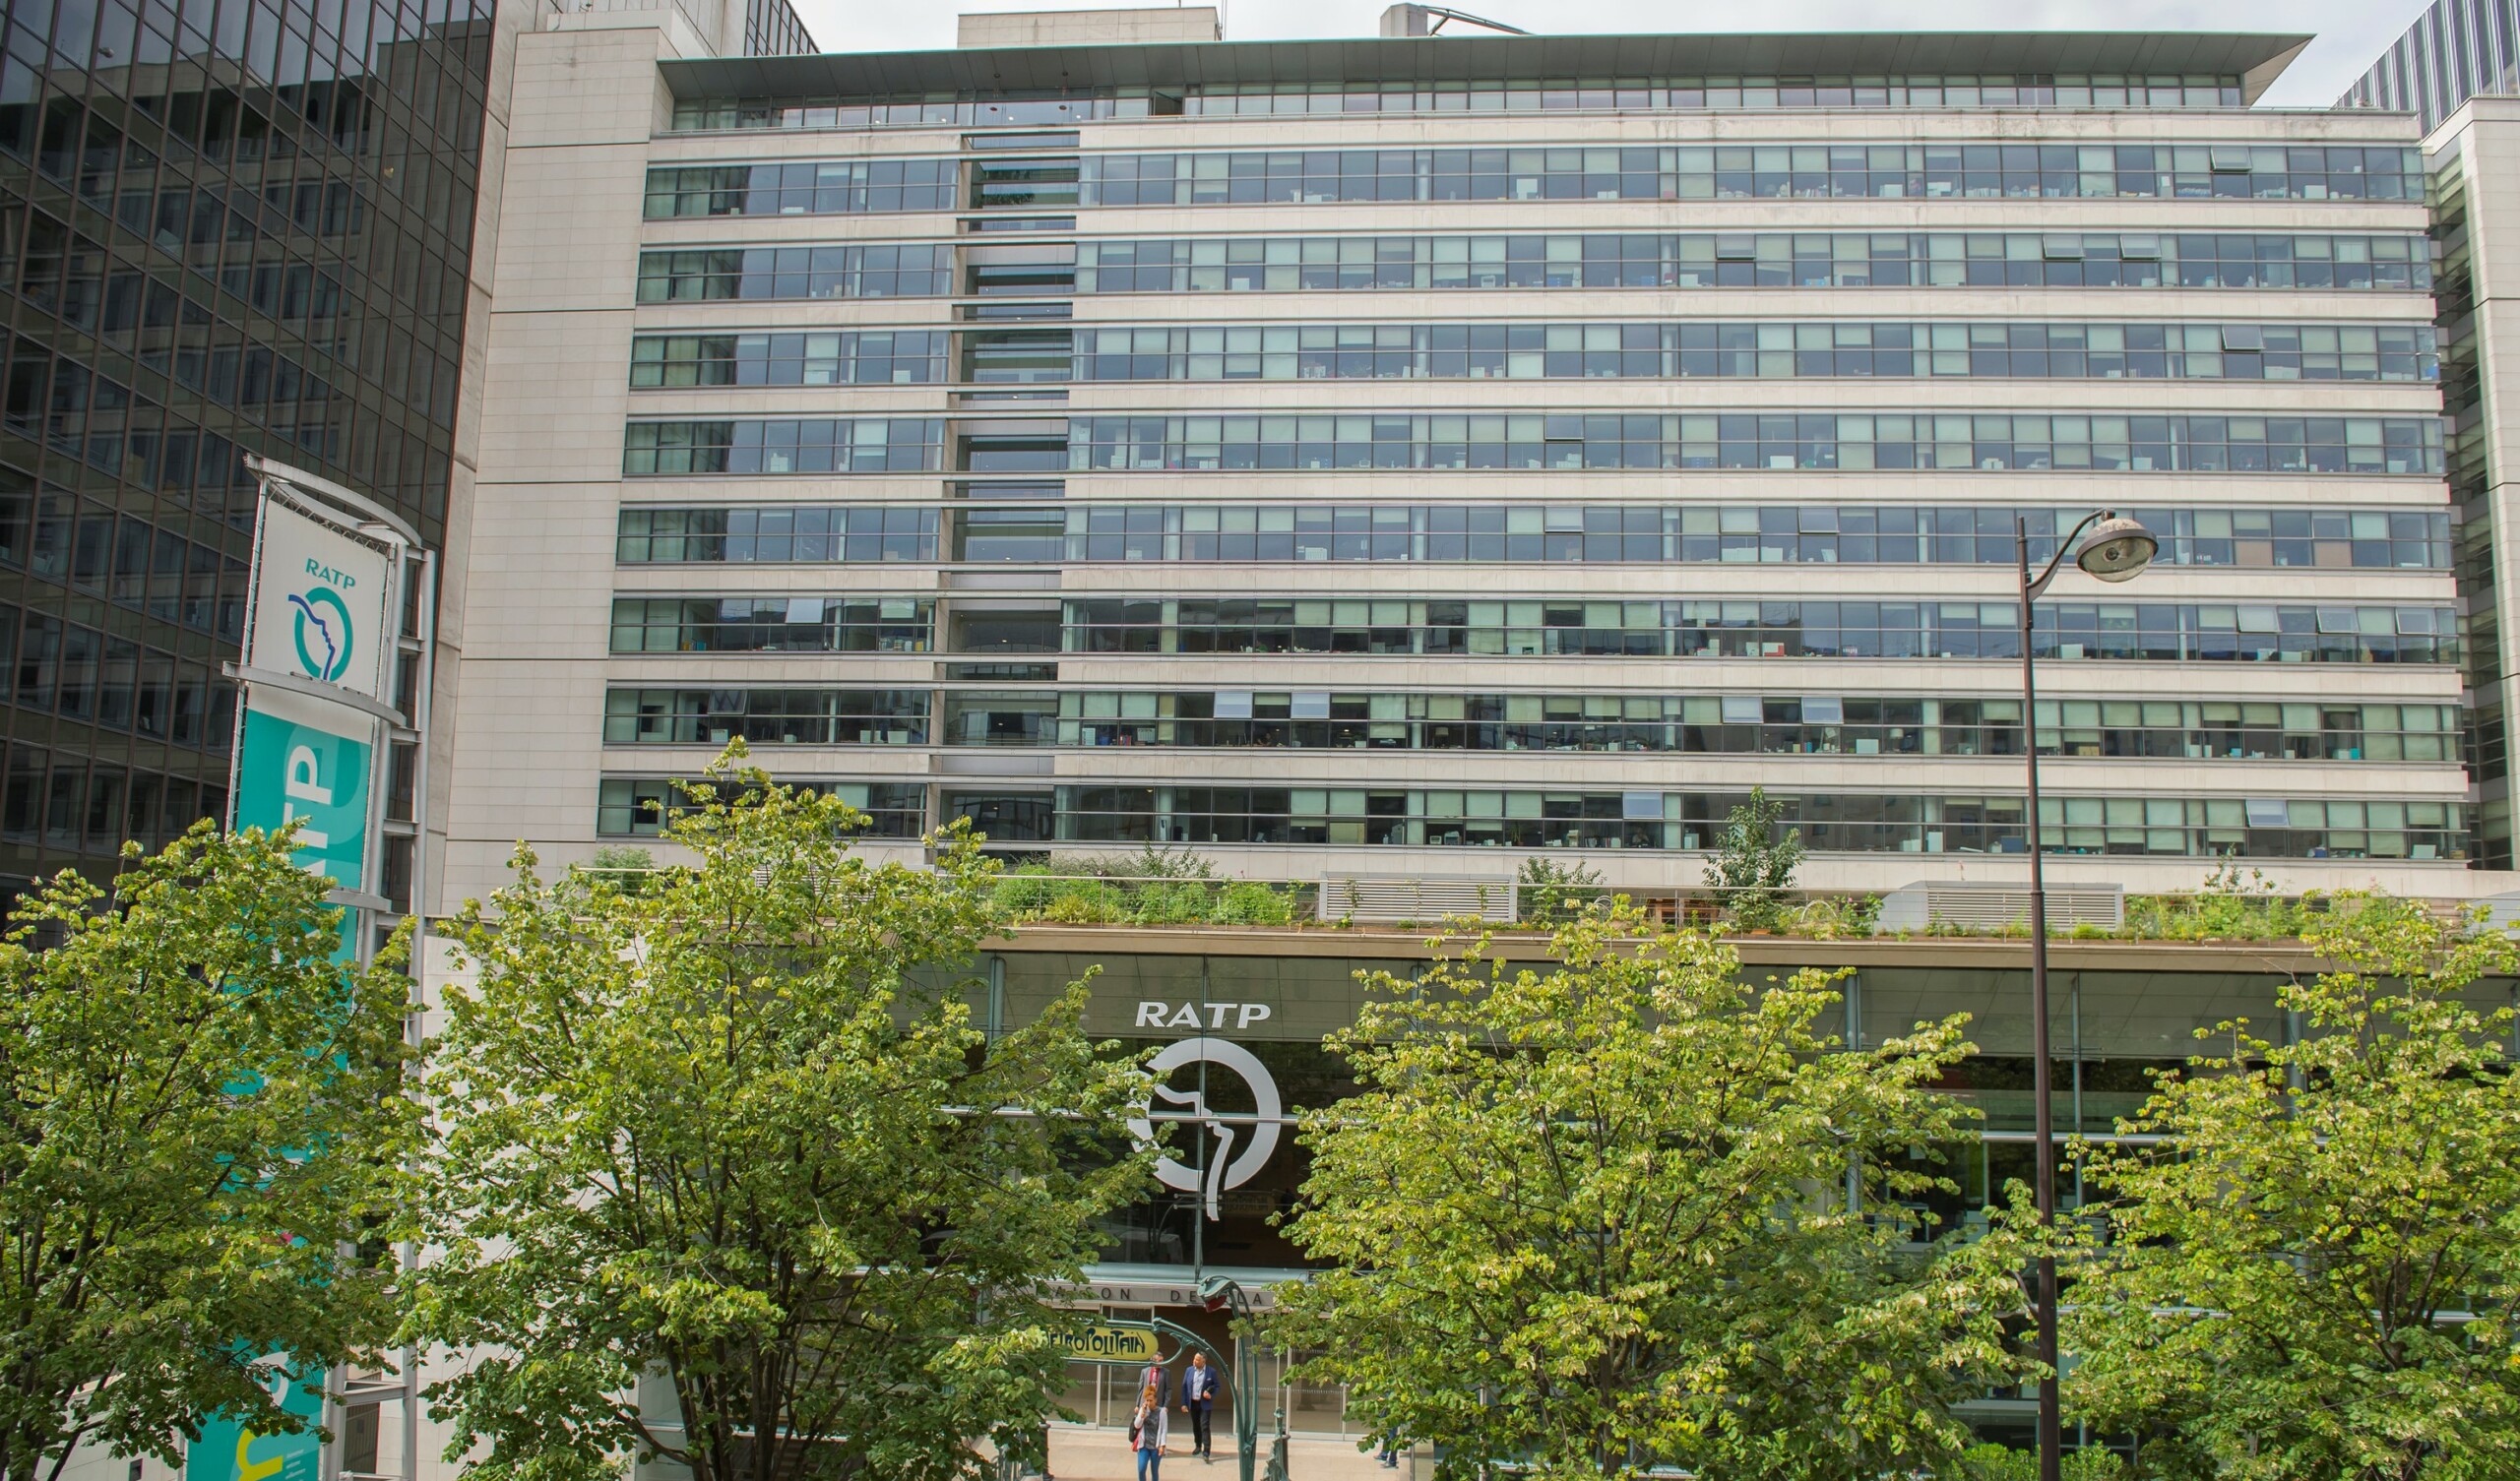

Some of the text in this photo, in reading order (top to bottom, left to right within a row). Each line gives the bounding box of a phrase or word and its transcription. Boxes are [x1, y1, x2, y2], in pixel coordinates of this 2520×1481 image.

[305, 557, 356, 589] RATP
[1135, 1001, 1271, 1029] RATP
[1169, 1289, 1198, 1303] DE
[1046, 1327, 1146, 1356] EROPOLITAIN
